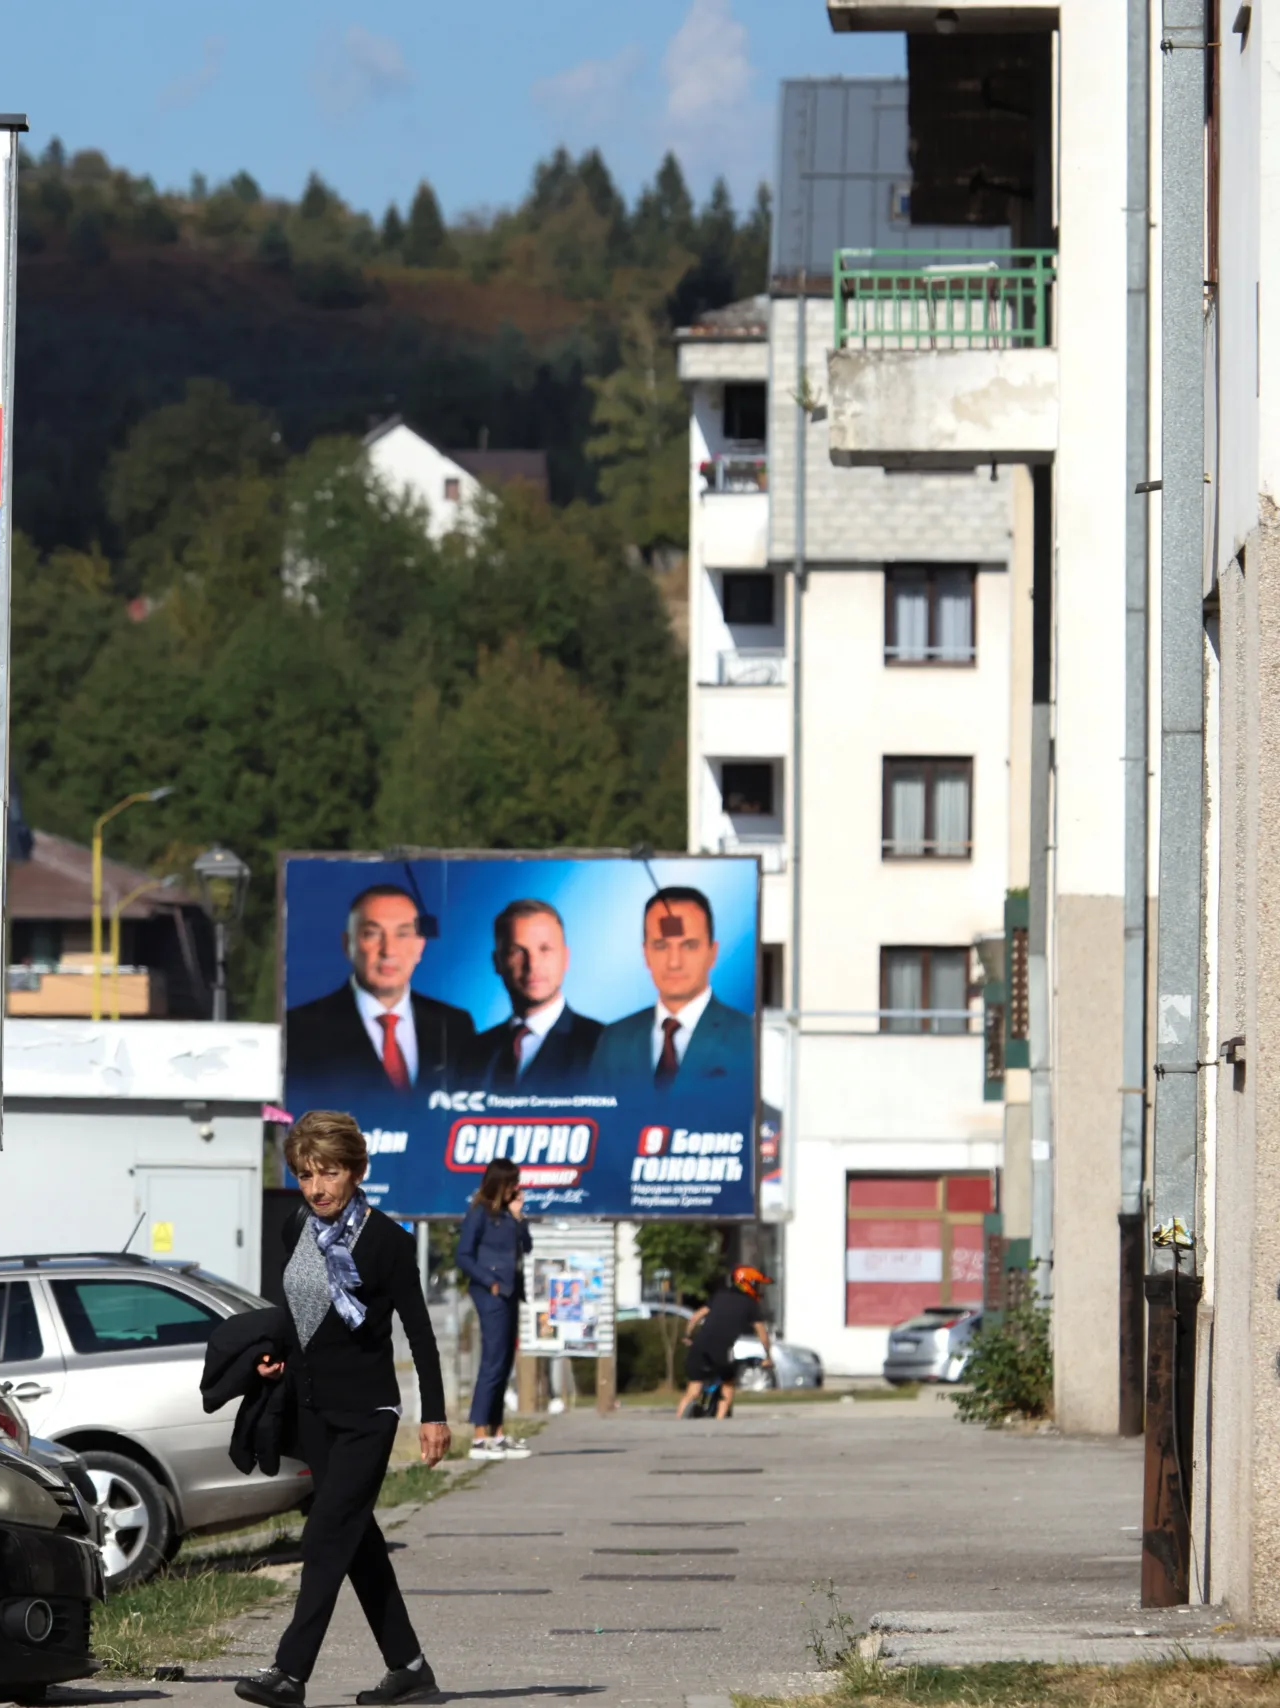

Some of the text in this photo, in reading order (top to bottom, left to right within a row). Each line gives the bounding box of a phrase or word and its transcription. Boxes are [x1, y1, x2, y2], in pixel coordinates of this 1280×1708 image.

[453, 1124, 590, 1164] СИГУРНО
[671, 1128, 744, 1155] Борис
[630, 1156, 743, 1182] ГОЈКОВИЋ
